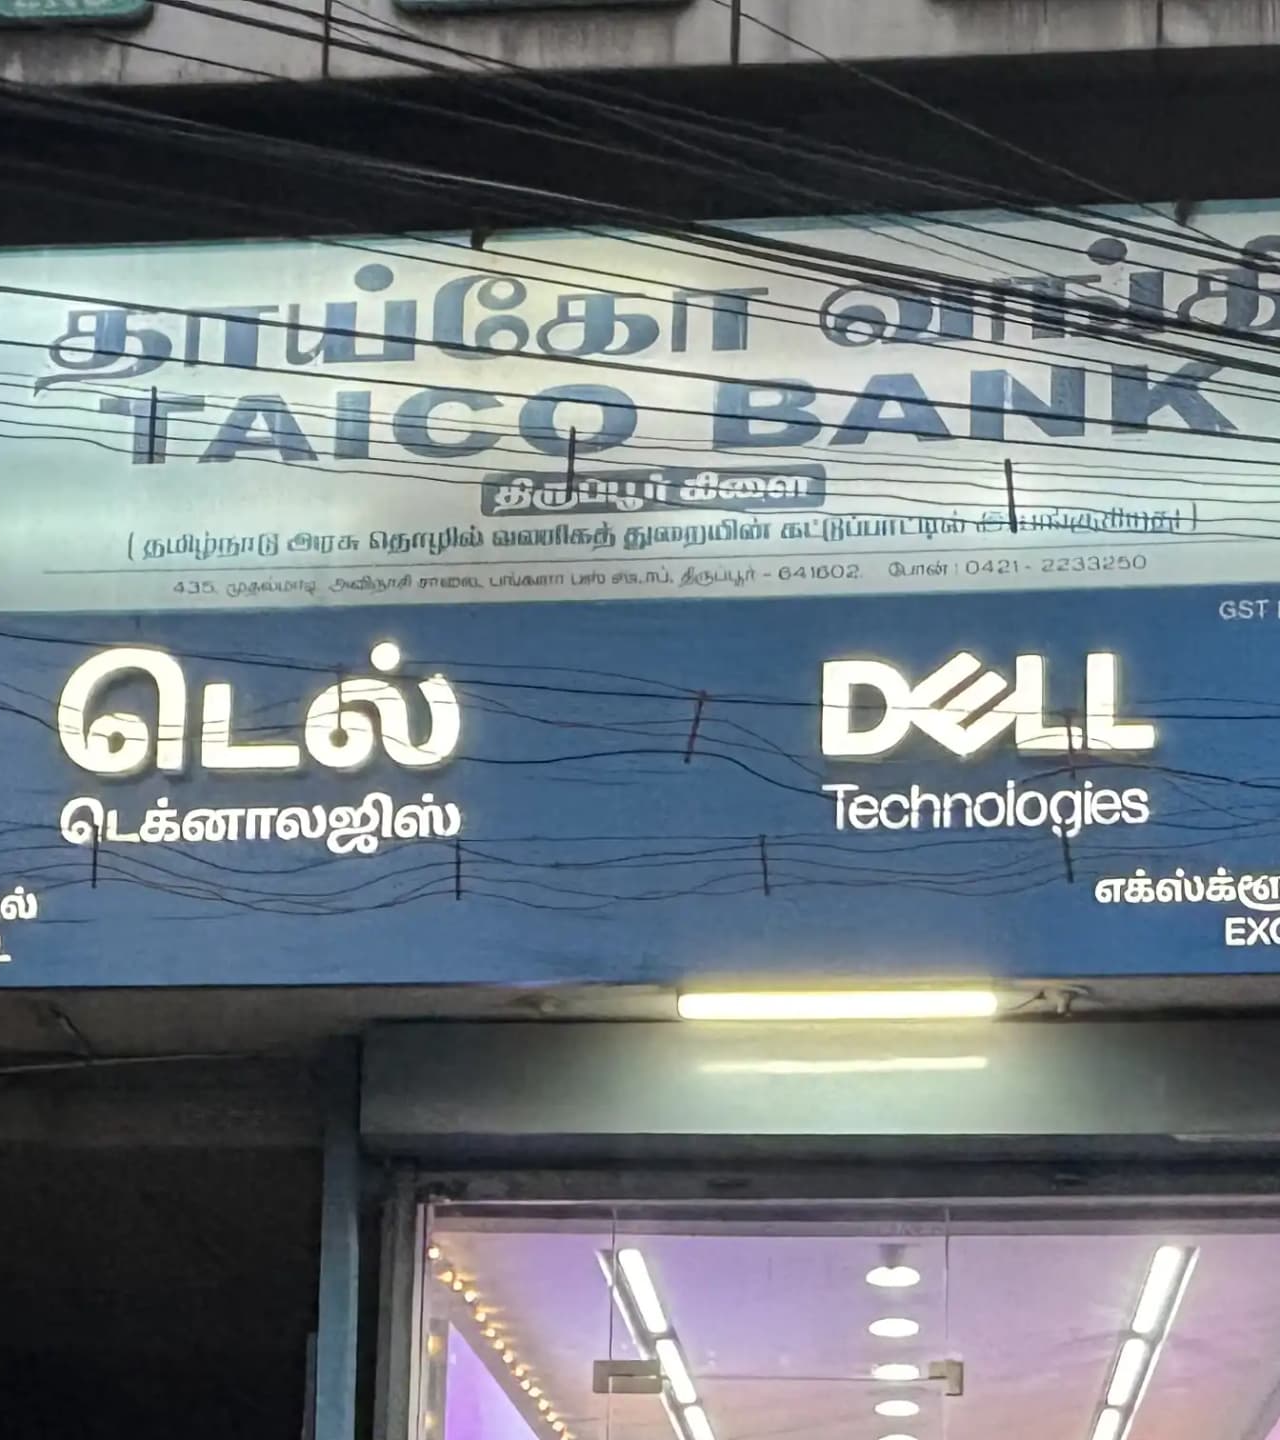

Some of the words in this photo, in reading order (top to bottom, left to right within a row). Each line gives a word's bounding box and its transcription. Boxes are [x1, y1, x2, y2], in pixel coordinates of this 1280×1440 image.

[33, 263, 768, 397] தாய்கோ
[99, 383, 638, 465] TAICO
[711, 361, 1241, 453] BANK
[287, 532, 361, 553] அரசு
[965, 559, 1021, 575] 0421
[1218, 599, 1270, 620] GST
[56, 641, 461, 776] டெல்
[820, 650, 1157, 758] DELL
[59, 792, 463, 855] டெக்னாலஜிஸ்
[821, 781, 1151, 839] Technologies
